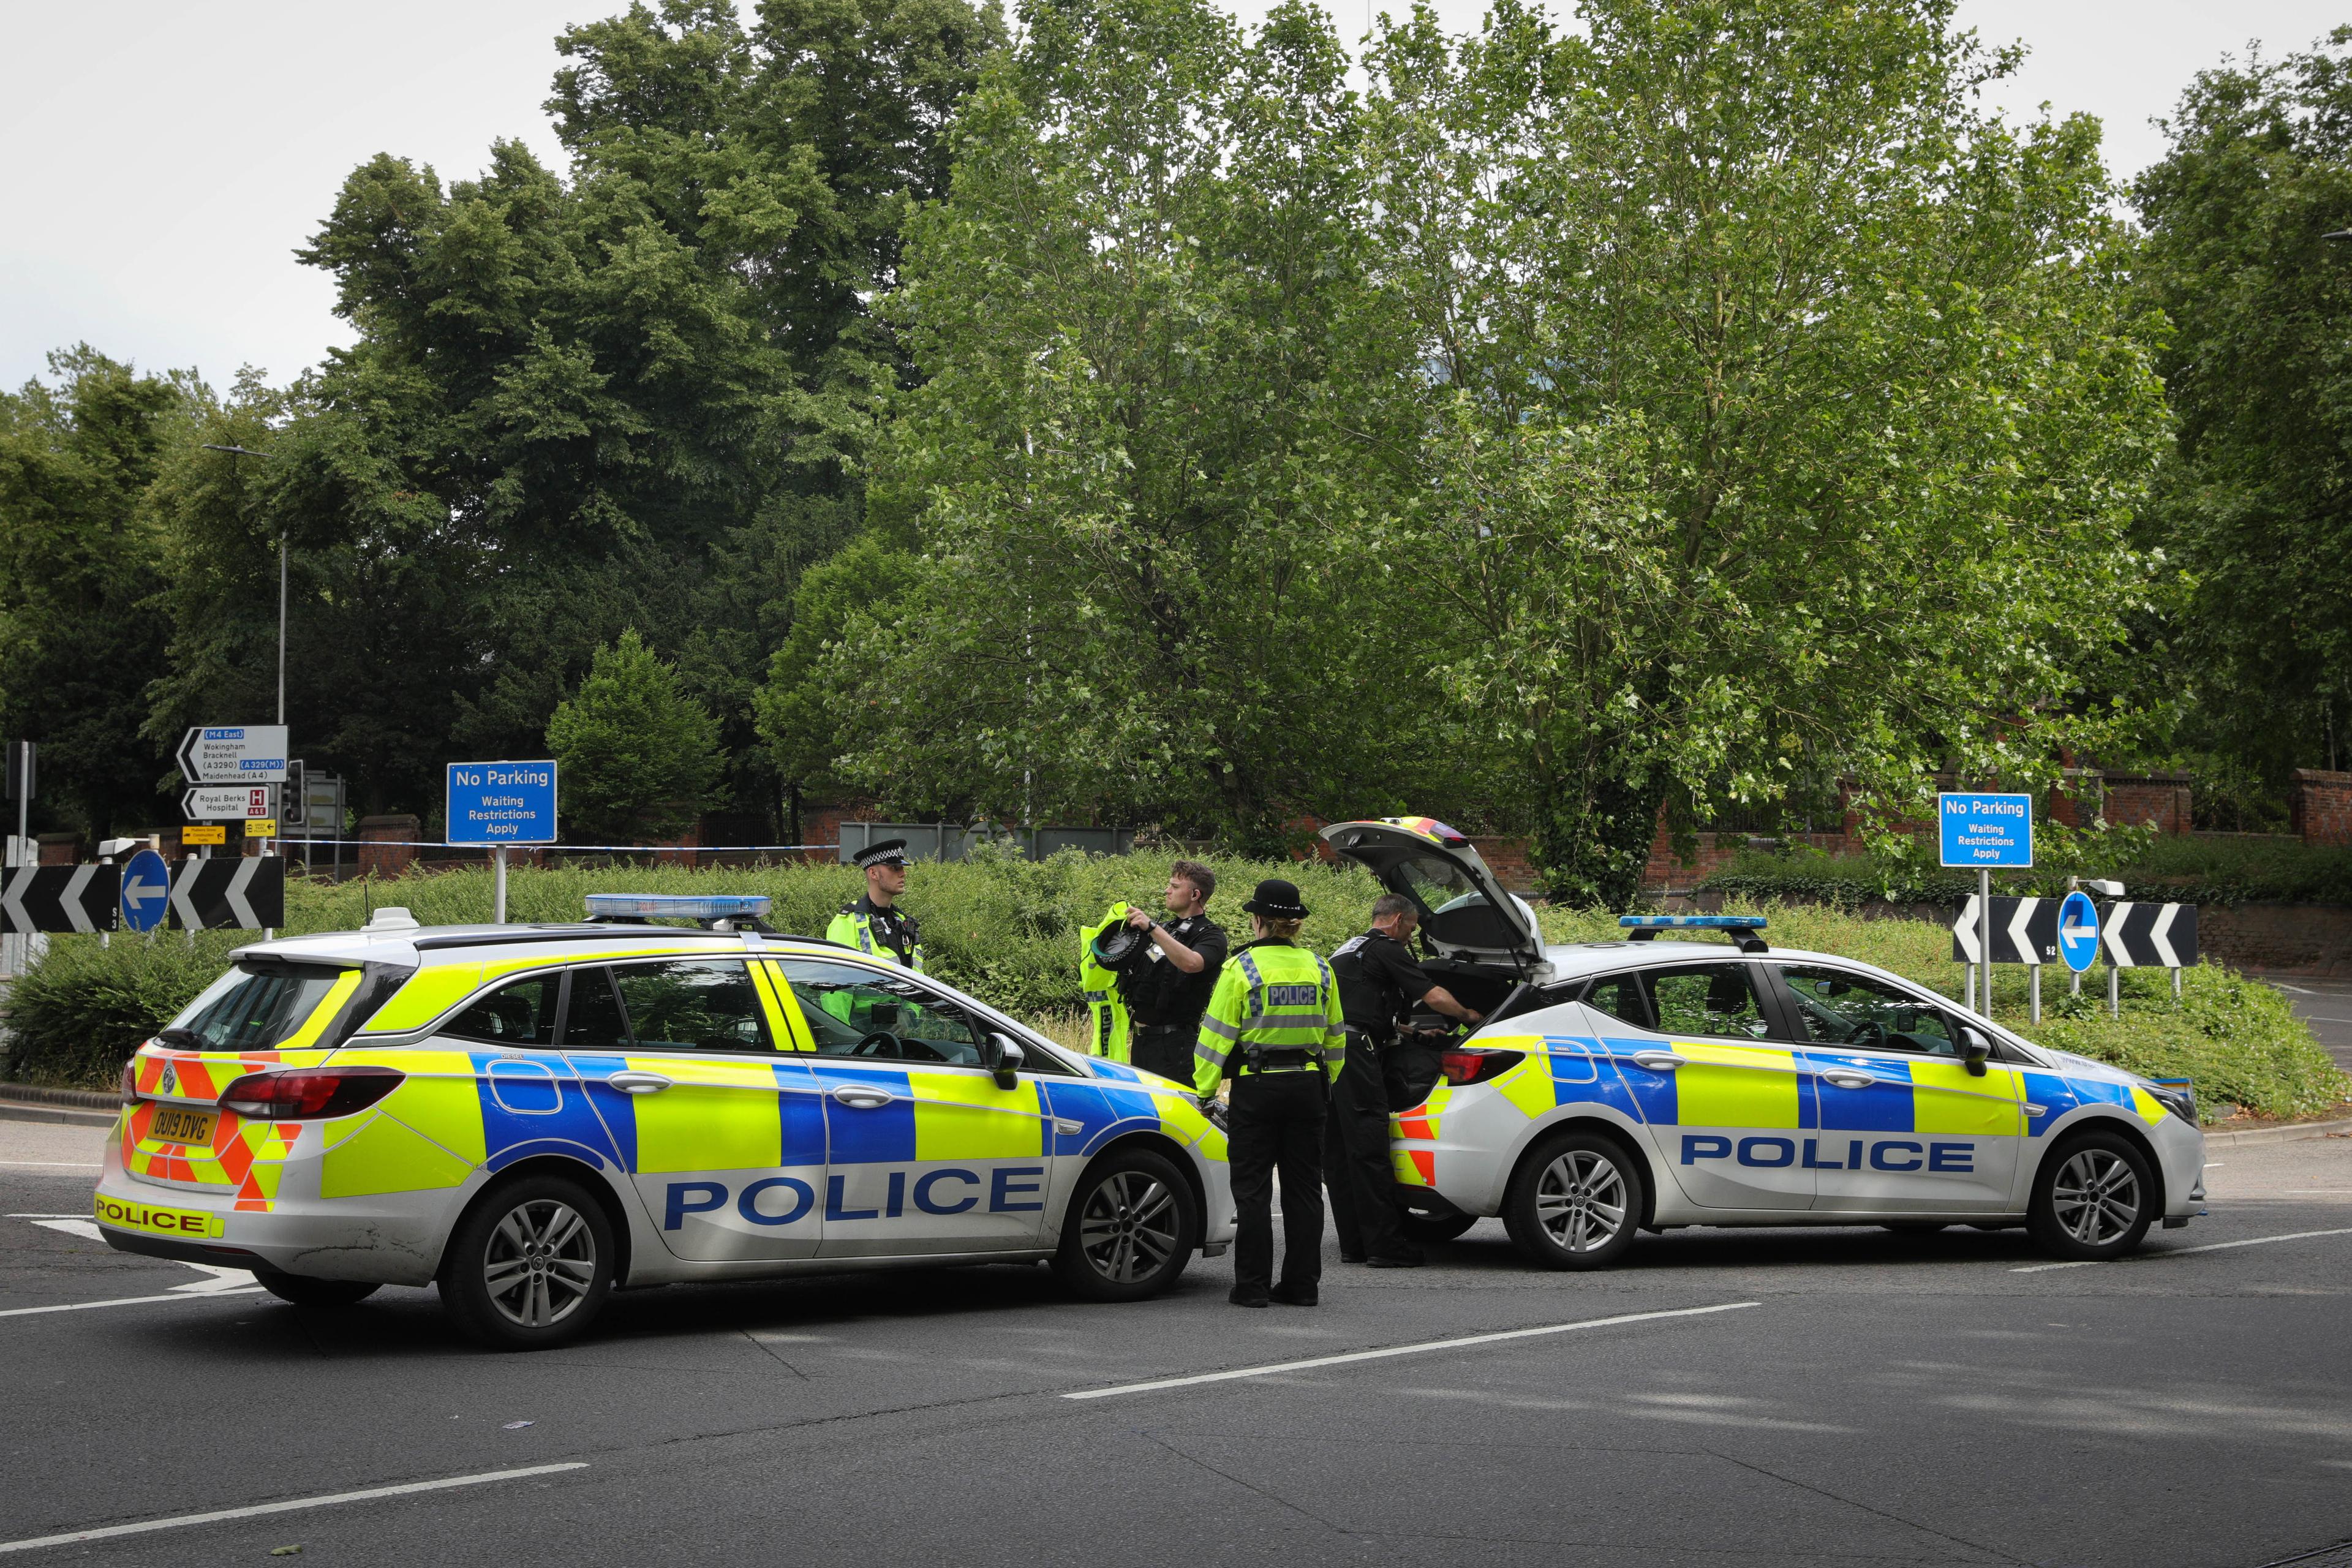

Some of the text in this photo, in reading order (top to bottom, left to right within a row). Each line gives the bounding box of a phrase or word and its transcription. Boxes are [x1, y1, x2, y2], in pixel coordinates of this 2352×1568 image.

[224, 729, 244, 739] East)
[456, 769, 548, 787] No Parking
[481, 796, 524, 807] Waiting
[469, 809, 537, 821] Restrictions
[1946, 801, 2024, 818] No Parking
[486, 823, 519, 835] Apply
[1969, 824, 2005, 835] Waiting
[1958, 835, 2015, 846] Restrictions
[1973, 848, 2000, 860] Apply
[2046, 945, 2056, 956] S2
[1270, 986, 1315, 1005] POLICE
[154, 1112, 208, 1140] OU19 DVG
[1680, 1134, 1975, 1173] POLICE
[663, 1167, 1044, 1231] POLICE
[96, 1199, 205, 1233] POLICE
